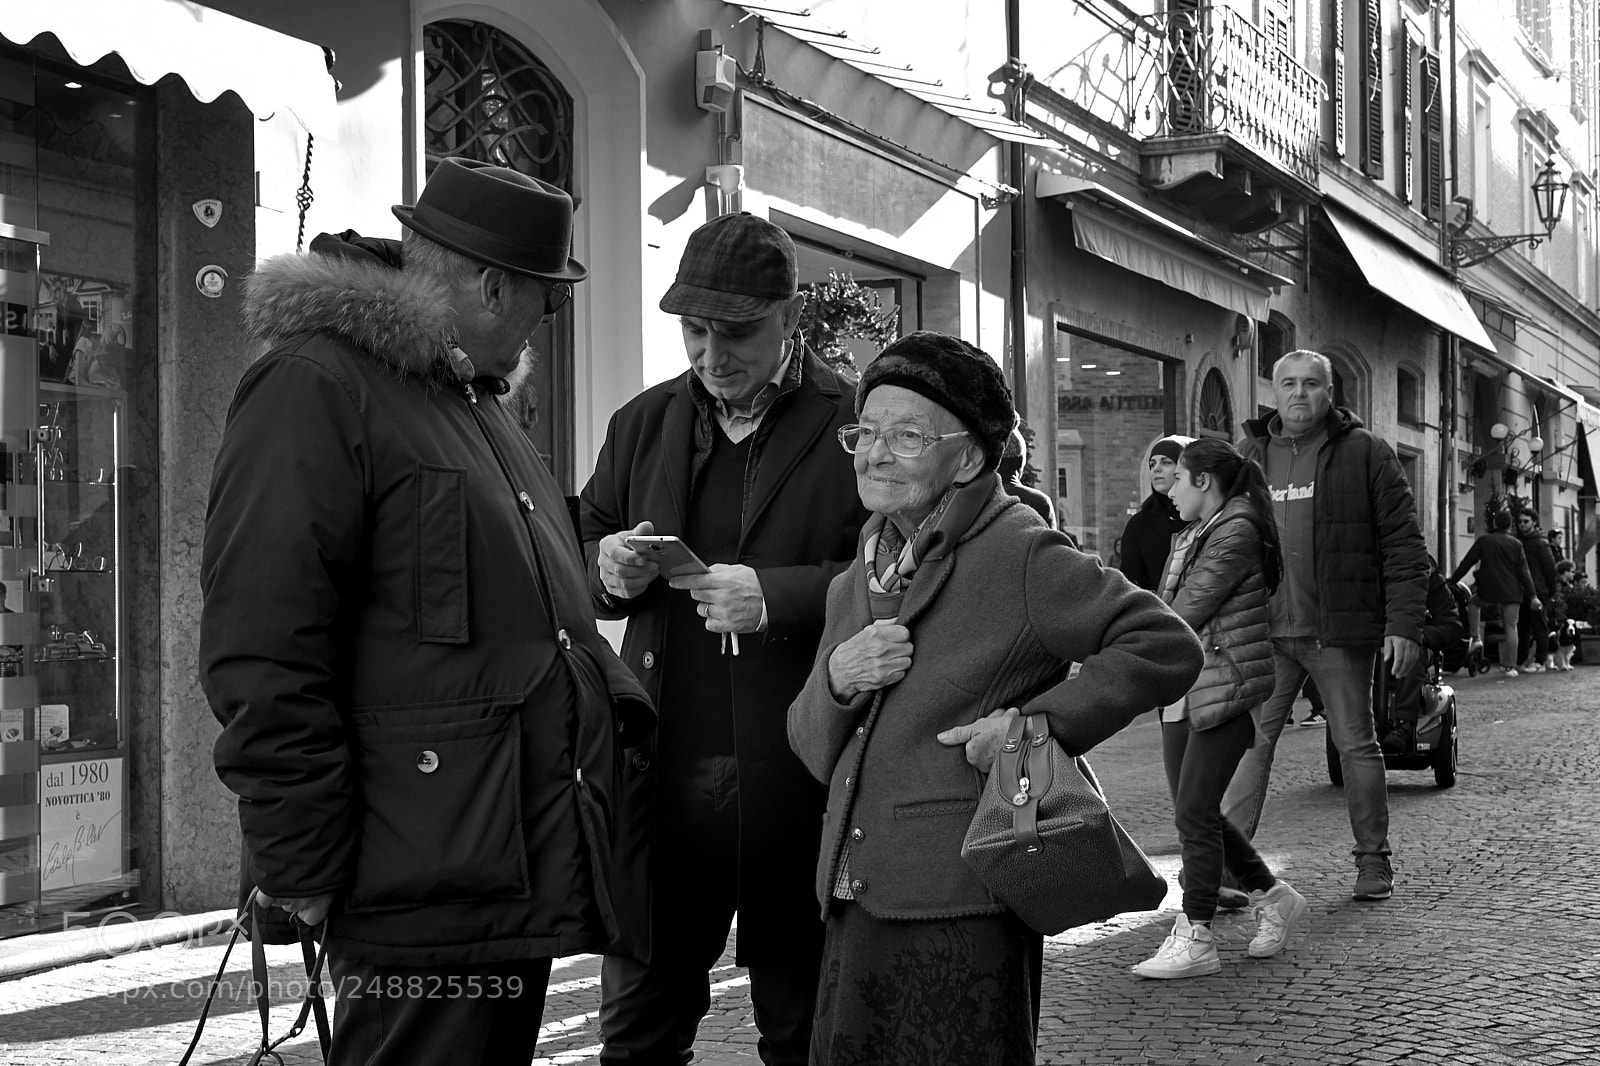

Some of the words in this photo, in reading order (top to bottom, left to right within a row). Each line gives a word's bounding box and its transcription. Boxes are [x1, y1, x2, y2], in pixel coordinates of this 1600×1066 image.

[46, 771, 64, 788] dal
[70, 761, 109, 786] 1980
[45, 793, 95, 807] NOVOTTICA
